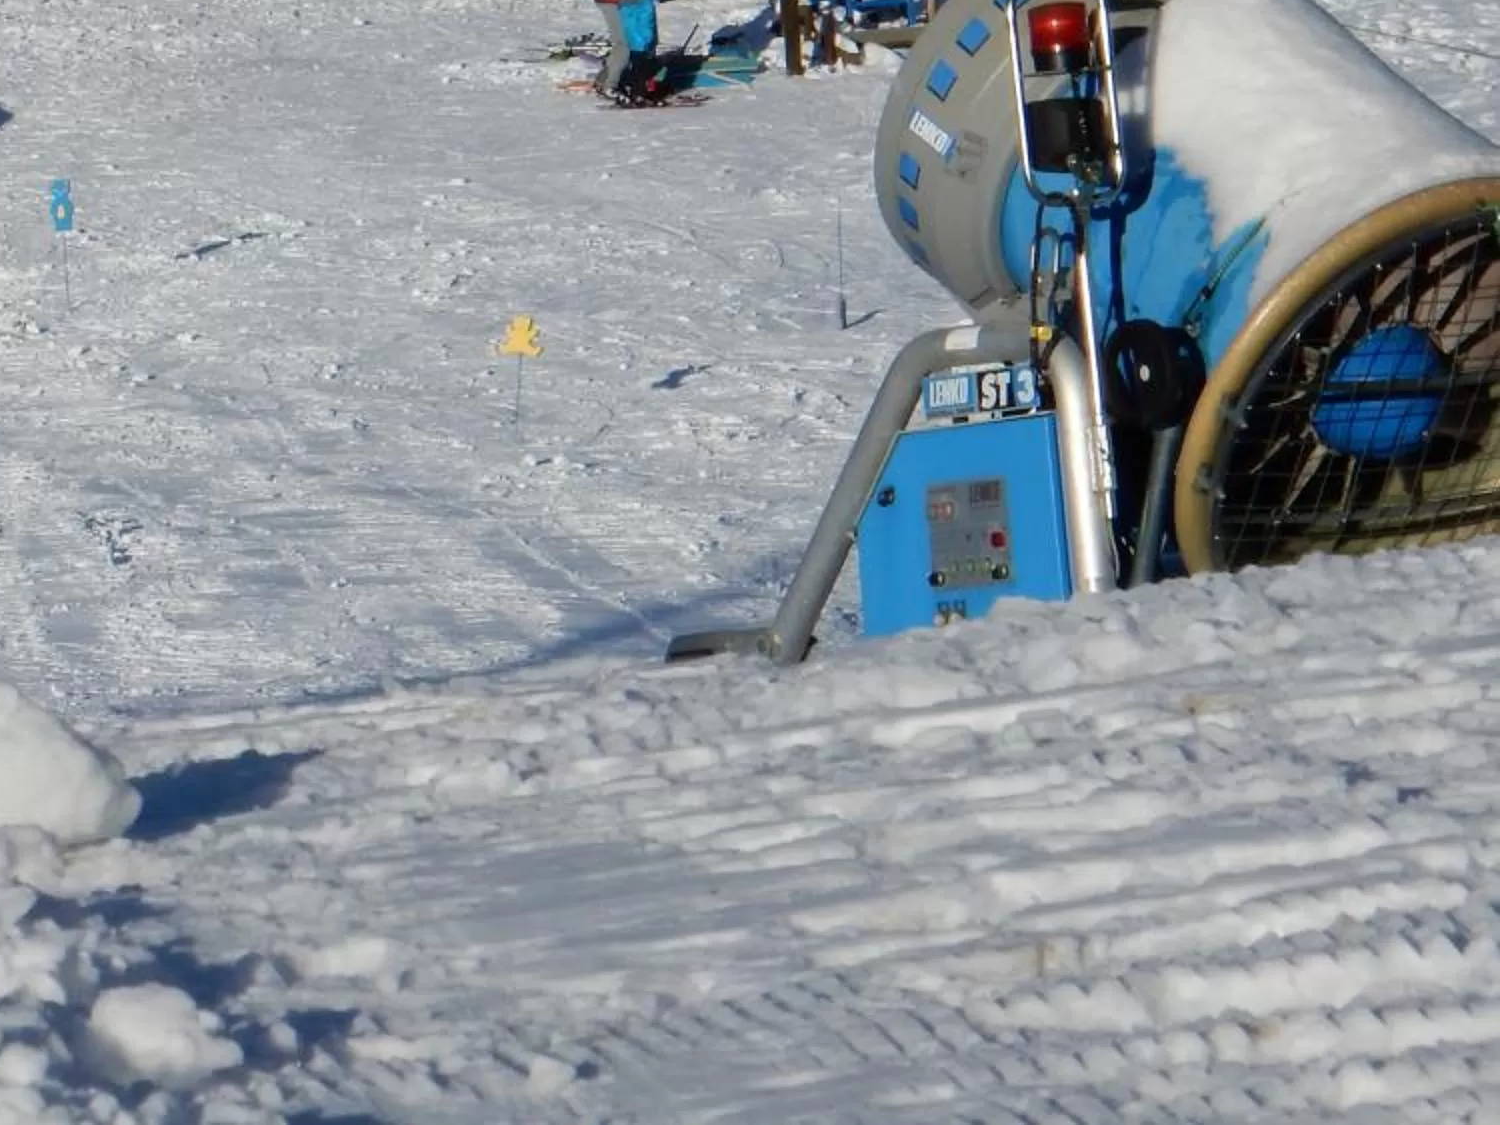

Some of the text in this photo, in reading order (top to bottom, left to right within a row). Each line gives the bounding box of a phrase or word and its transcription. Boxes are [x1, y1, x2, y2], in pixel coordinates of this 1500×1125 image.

[929, 377, 968, 408] LENKO
[981, 371, 1035, 410] ST 3
